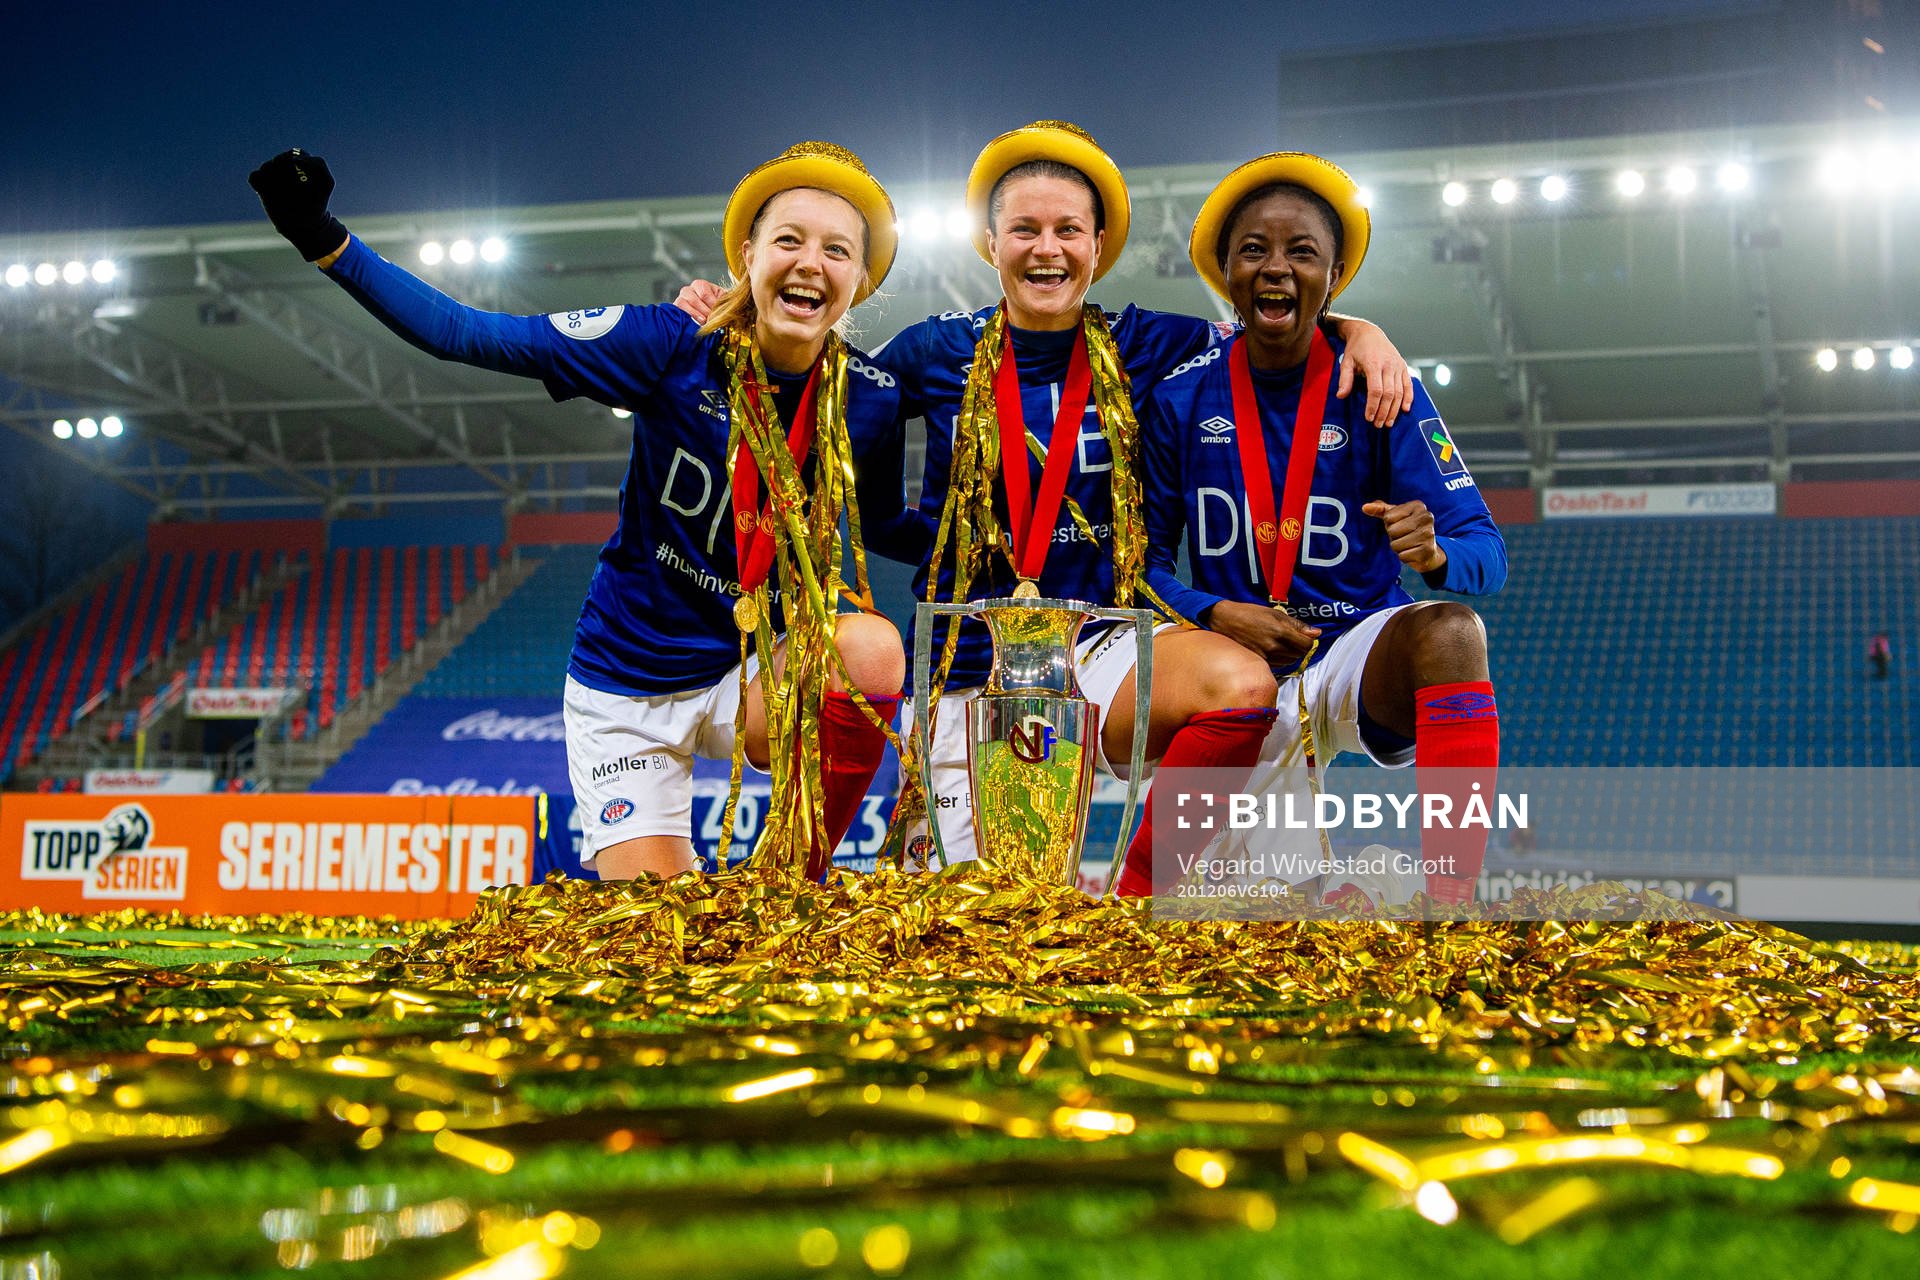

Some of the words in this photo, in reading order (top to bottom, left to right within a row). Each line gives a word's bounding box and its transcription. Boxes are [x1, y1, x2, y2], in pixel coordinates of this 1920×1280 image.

[847, 356, 896, 388] oop
[699, 404, 727, 422] umbro
[1201, 434, 1231, 444] umbro
[1444, 474, 1474, 491] umb
[652, 755, 668, 770] Bil
[32, 830, 101, 870] TOPP
[218, 821, 528, 894] SERIEMESTER
[96, 856, 180, 891] SERIEN
